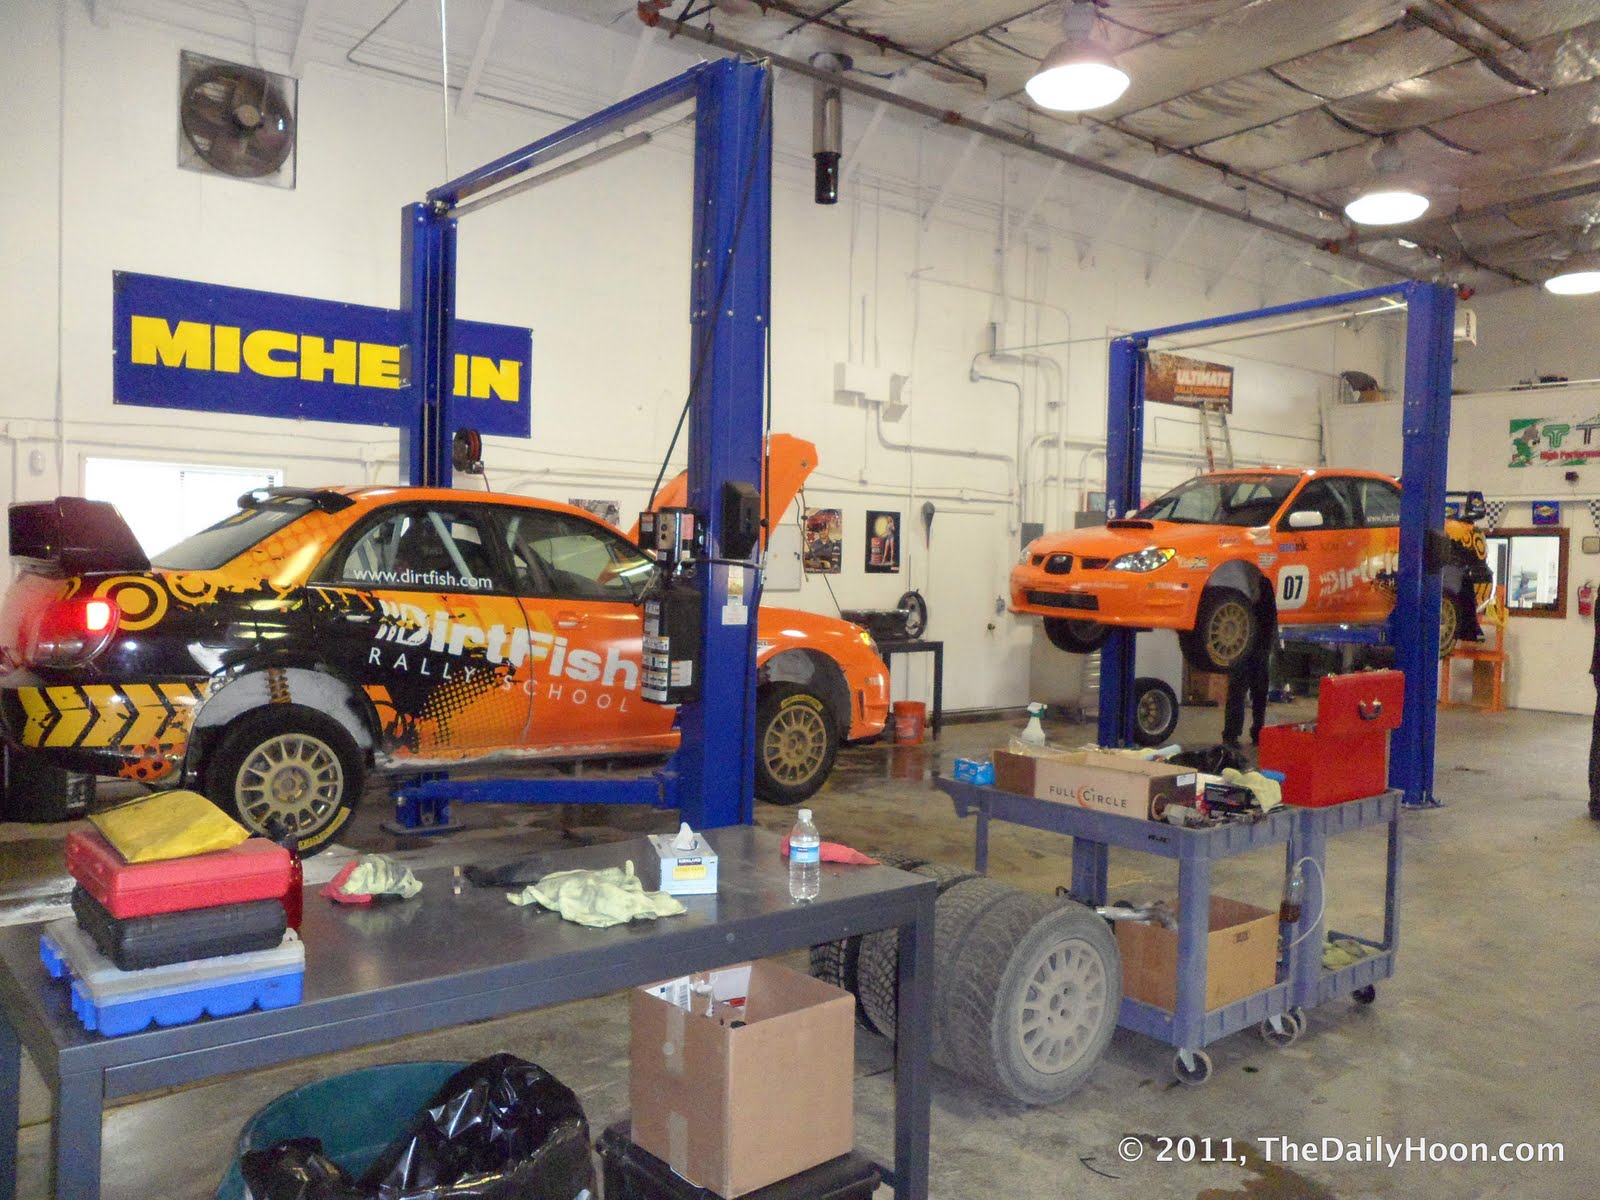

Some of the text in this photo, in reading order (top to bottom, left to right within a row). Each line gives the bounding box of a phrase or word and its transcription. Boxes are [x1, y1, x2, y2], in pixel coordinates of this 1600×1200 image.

[131, 314, 520, 403] MICHEIN
[353, 568, 493, 588] www.dirtfish.com
[1282, 574, 1303, 600] 07
[375, 600, 640, 690] DirtFish
[368, 646, 629, 713] RALLY SCHOOL
[1049, 785, 1076, 799] FULL
